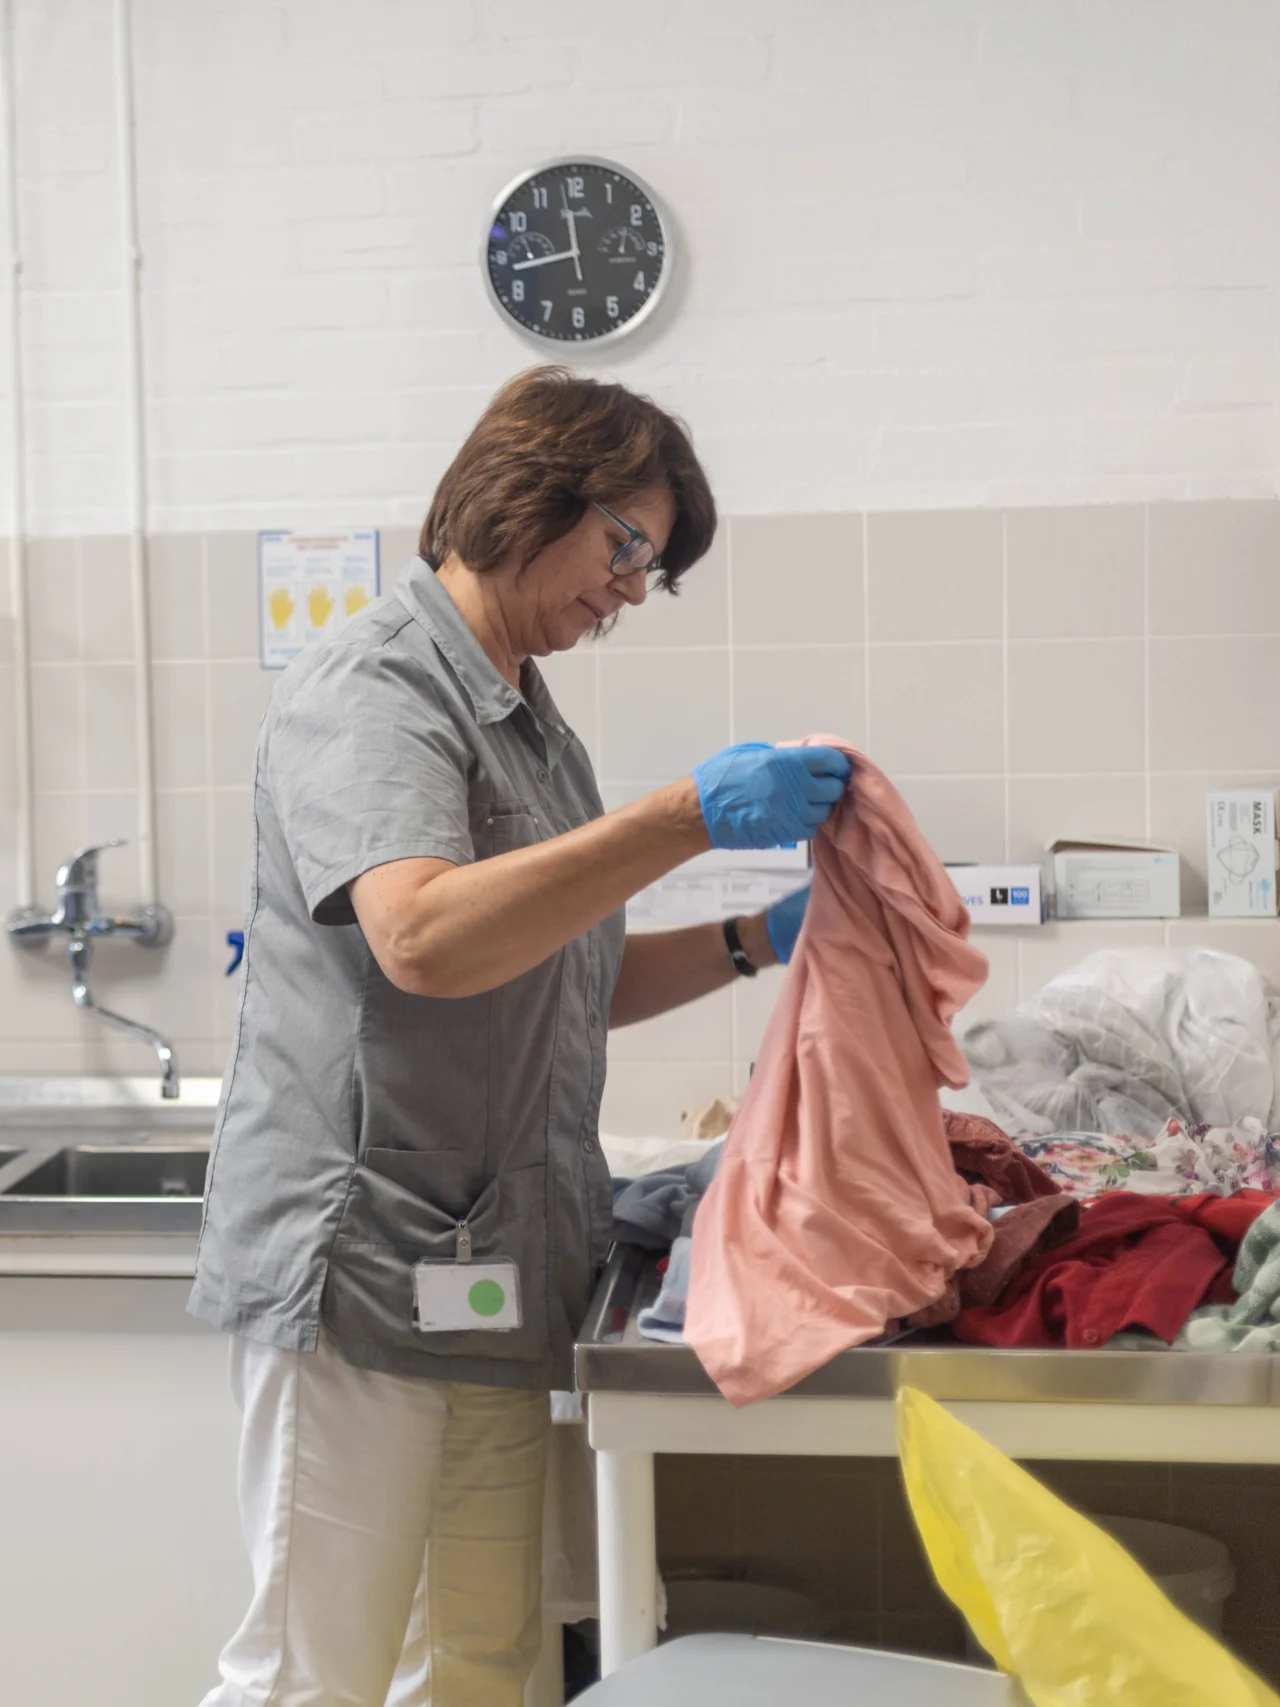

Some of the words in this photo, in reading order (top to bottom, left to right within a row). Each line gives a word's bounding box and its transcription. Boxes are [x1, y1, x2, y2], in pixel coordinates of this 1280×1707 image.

[532, 187, 548, 209] 11
[566, 176, 585, 199] 12
[604, 182, 613, 204] 1
[508, 211, 527, 233] 10
[630, 204, 643, 226] 2
[511, 280, 525, 302] 8
[632, 270, 646, 292] 4
[541, 300, 554, 323] 7
[572, 307, 585, 328] 6
[606, 296, 619, 318] 5
[1252, 800, 1263, 835] MASK
